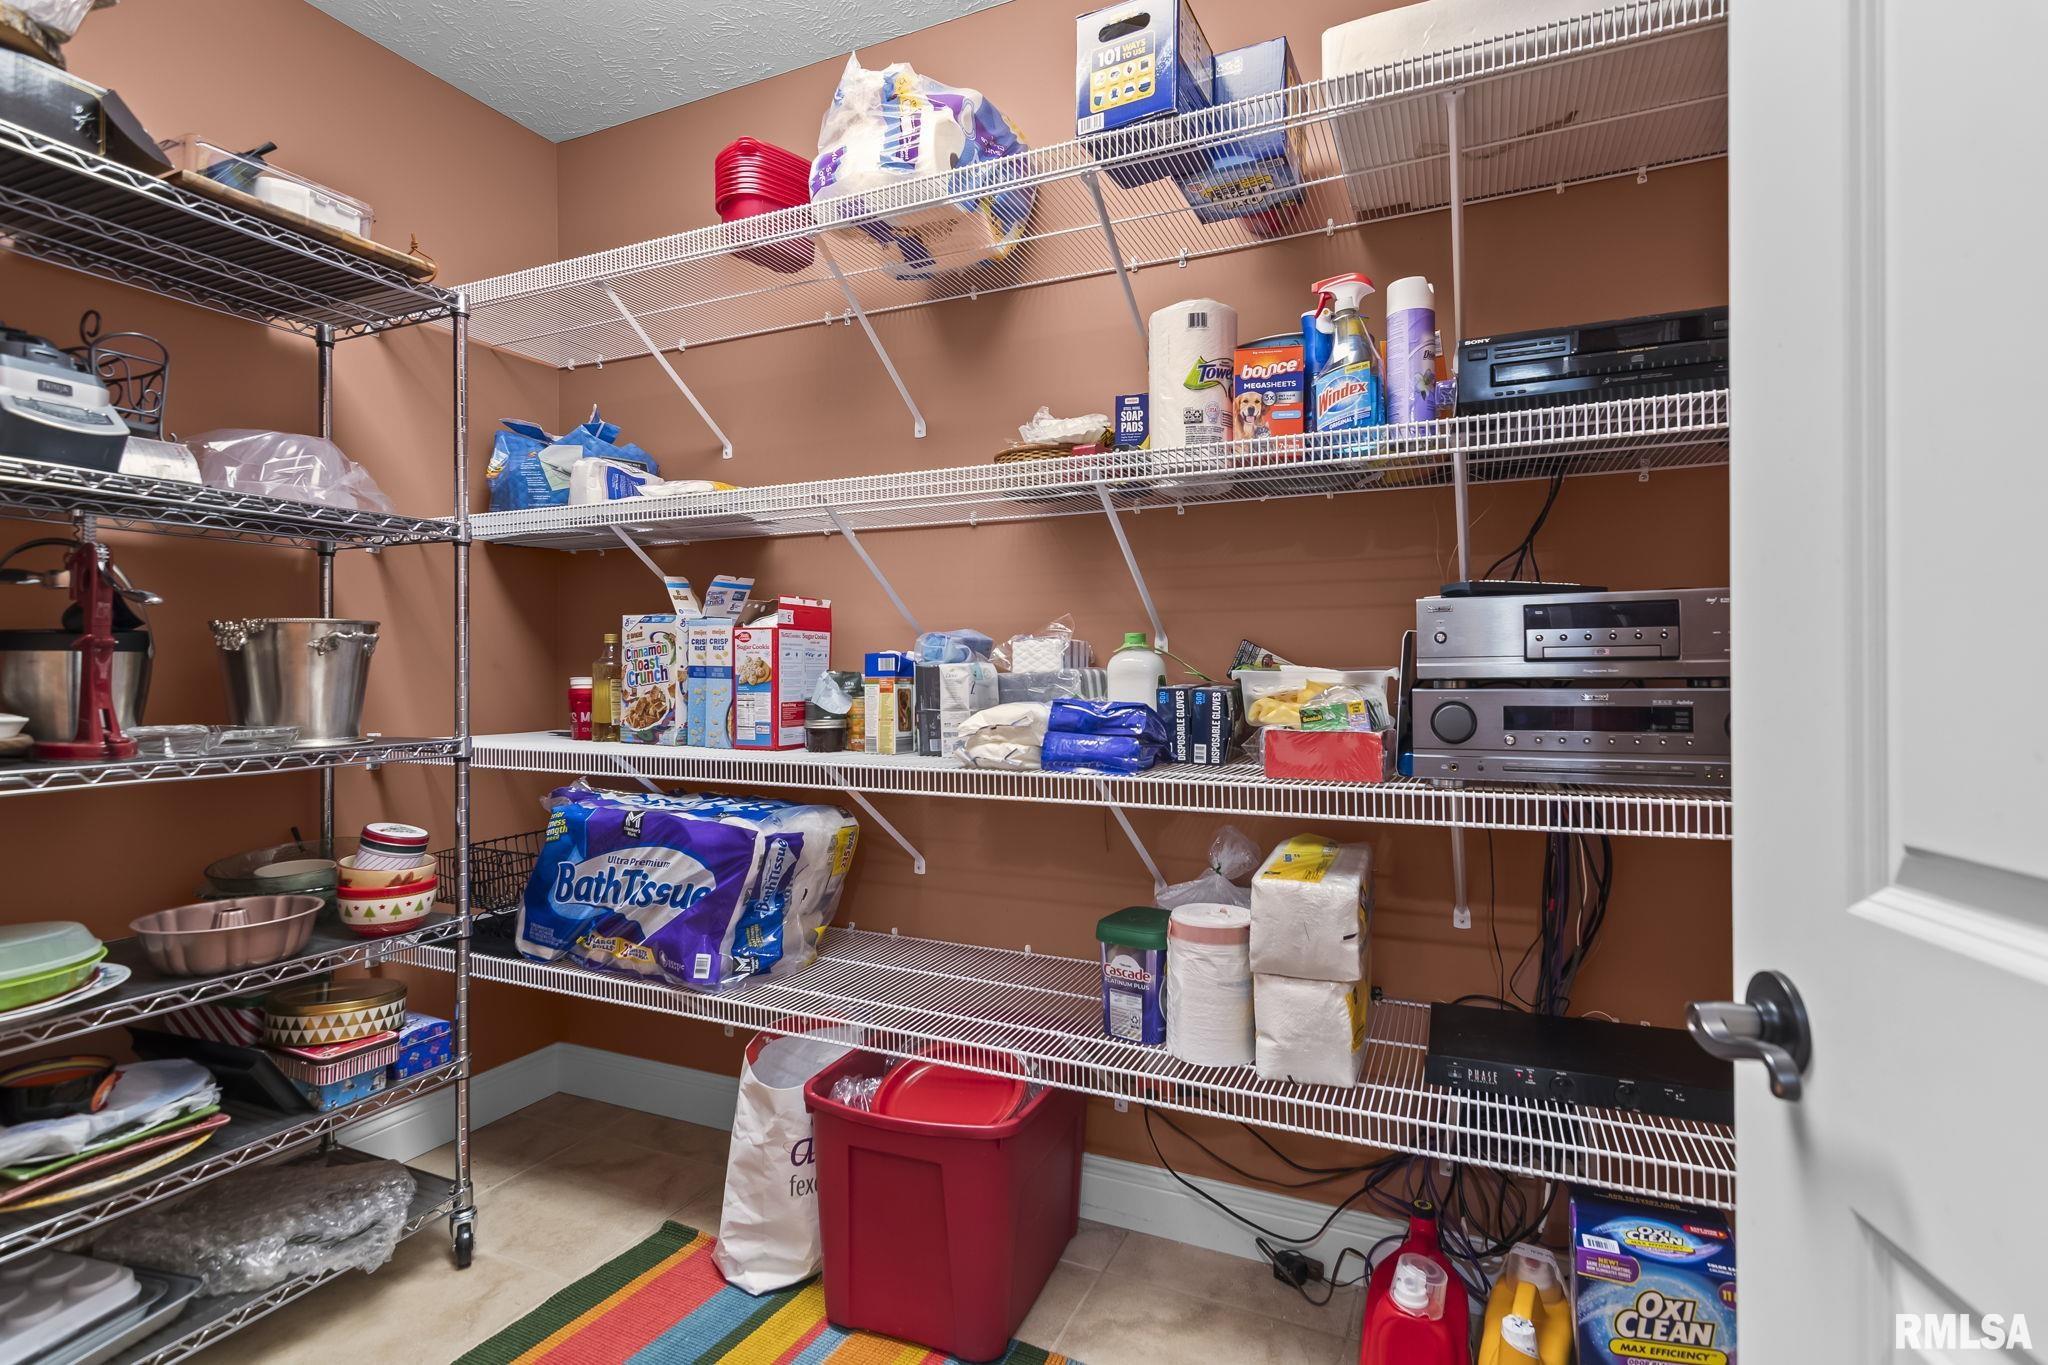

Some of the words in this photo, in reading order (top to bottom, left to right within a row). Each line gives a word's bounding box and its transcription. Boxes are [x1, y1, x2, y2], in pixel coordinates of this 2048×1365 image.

[1098, 46, 1120, 67] 101
[1122, 38, 1146, 52] WAYS
[1122, 51, 1132, 60] TO
[1131, 46, 1146, 58] USE
[1465, 337, 1491, 346] SONY
[1240, 359, 1298, 380] bounce
[1243, 380, 1297, 389] MEGASHEETS
[1318, 382, 1368, 418] Windex
[1120, 410, 1144, 421] SOAP
[1328, 415, 1353, 430] ORIGINAL
[1120, 421, 1144, 433] PADS
[787, 614, 792, 623] 5
[801, 632, 815, 641] Sugar
[626, 643, 668, 660] Cinnamon
[632, 655, 660, 671] Toast
[627, 665, 669, 686] Crunch
[1175, 690, 1185, 717] GLOVES
[1195, 692, 1203, 705] 500
[1211, 692, 1221, 720] GLOVES
[1302, 714, 1323, 723] Scotch
[1176, 718, 1186, 761] DISPOSABLE
[1211, 720, 1221, 764] DISPOSABLE
[1103, 963, 1152, 983] Cascade
[1133, 982, 1150, 991] PLUS
[1468, 1068, 1498, 1083] PHASE
[1626, 1231, 1684, 1246] CLEAN
[1638, 1226, 1671, 1238] OXI
[1598, 1257, 1618, 1267] NEW!
[1637, 1290, 1696, 1322] OXI
[1615, 1309, 1715, 1348] CLEAN
[1620, 1343, 1647, 1355] MAX
[1649, 1347, 1711, 1361] EFFICIENCY
